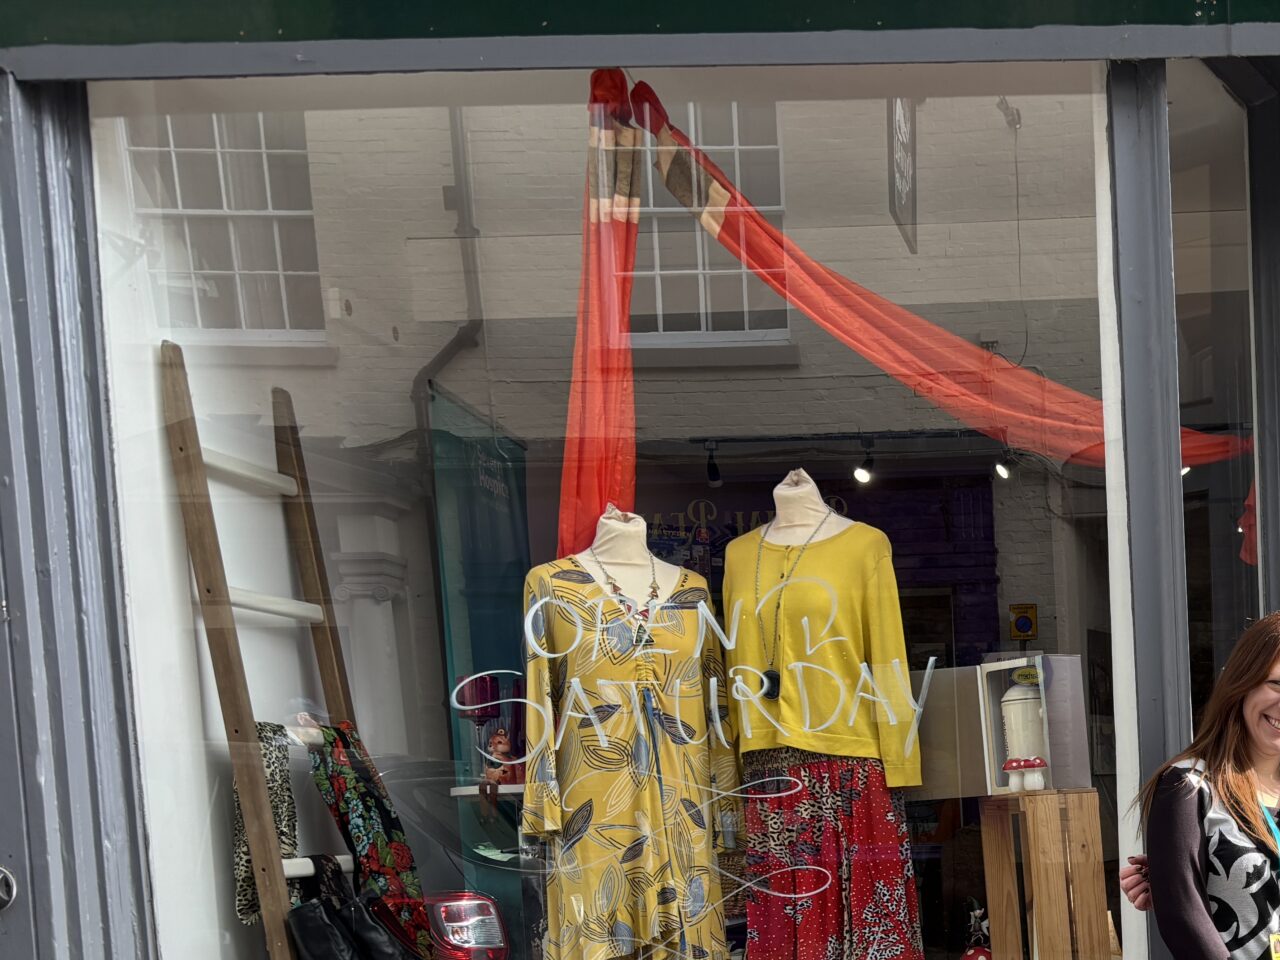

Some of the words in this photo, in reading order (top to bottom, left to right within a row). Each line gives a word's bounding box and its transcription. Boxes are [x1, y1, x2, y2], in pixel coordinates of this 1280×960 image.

[523, 595, 744, 661] OPEN
[755, 577, 848, 656] 2
[451, 655, 937, 765] SATURDAY
